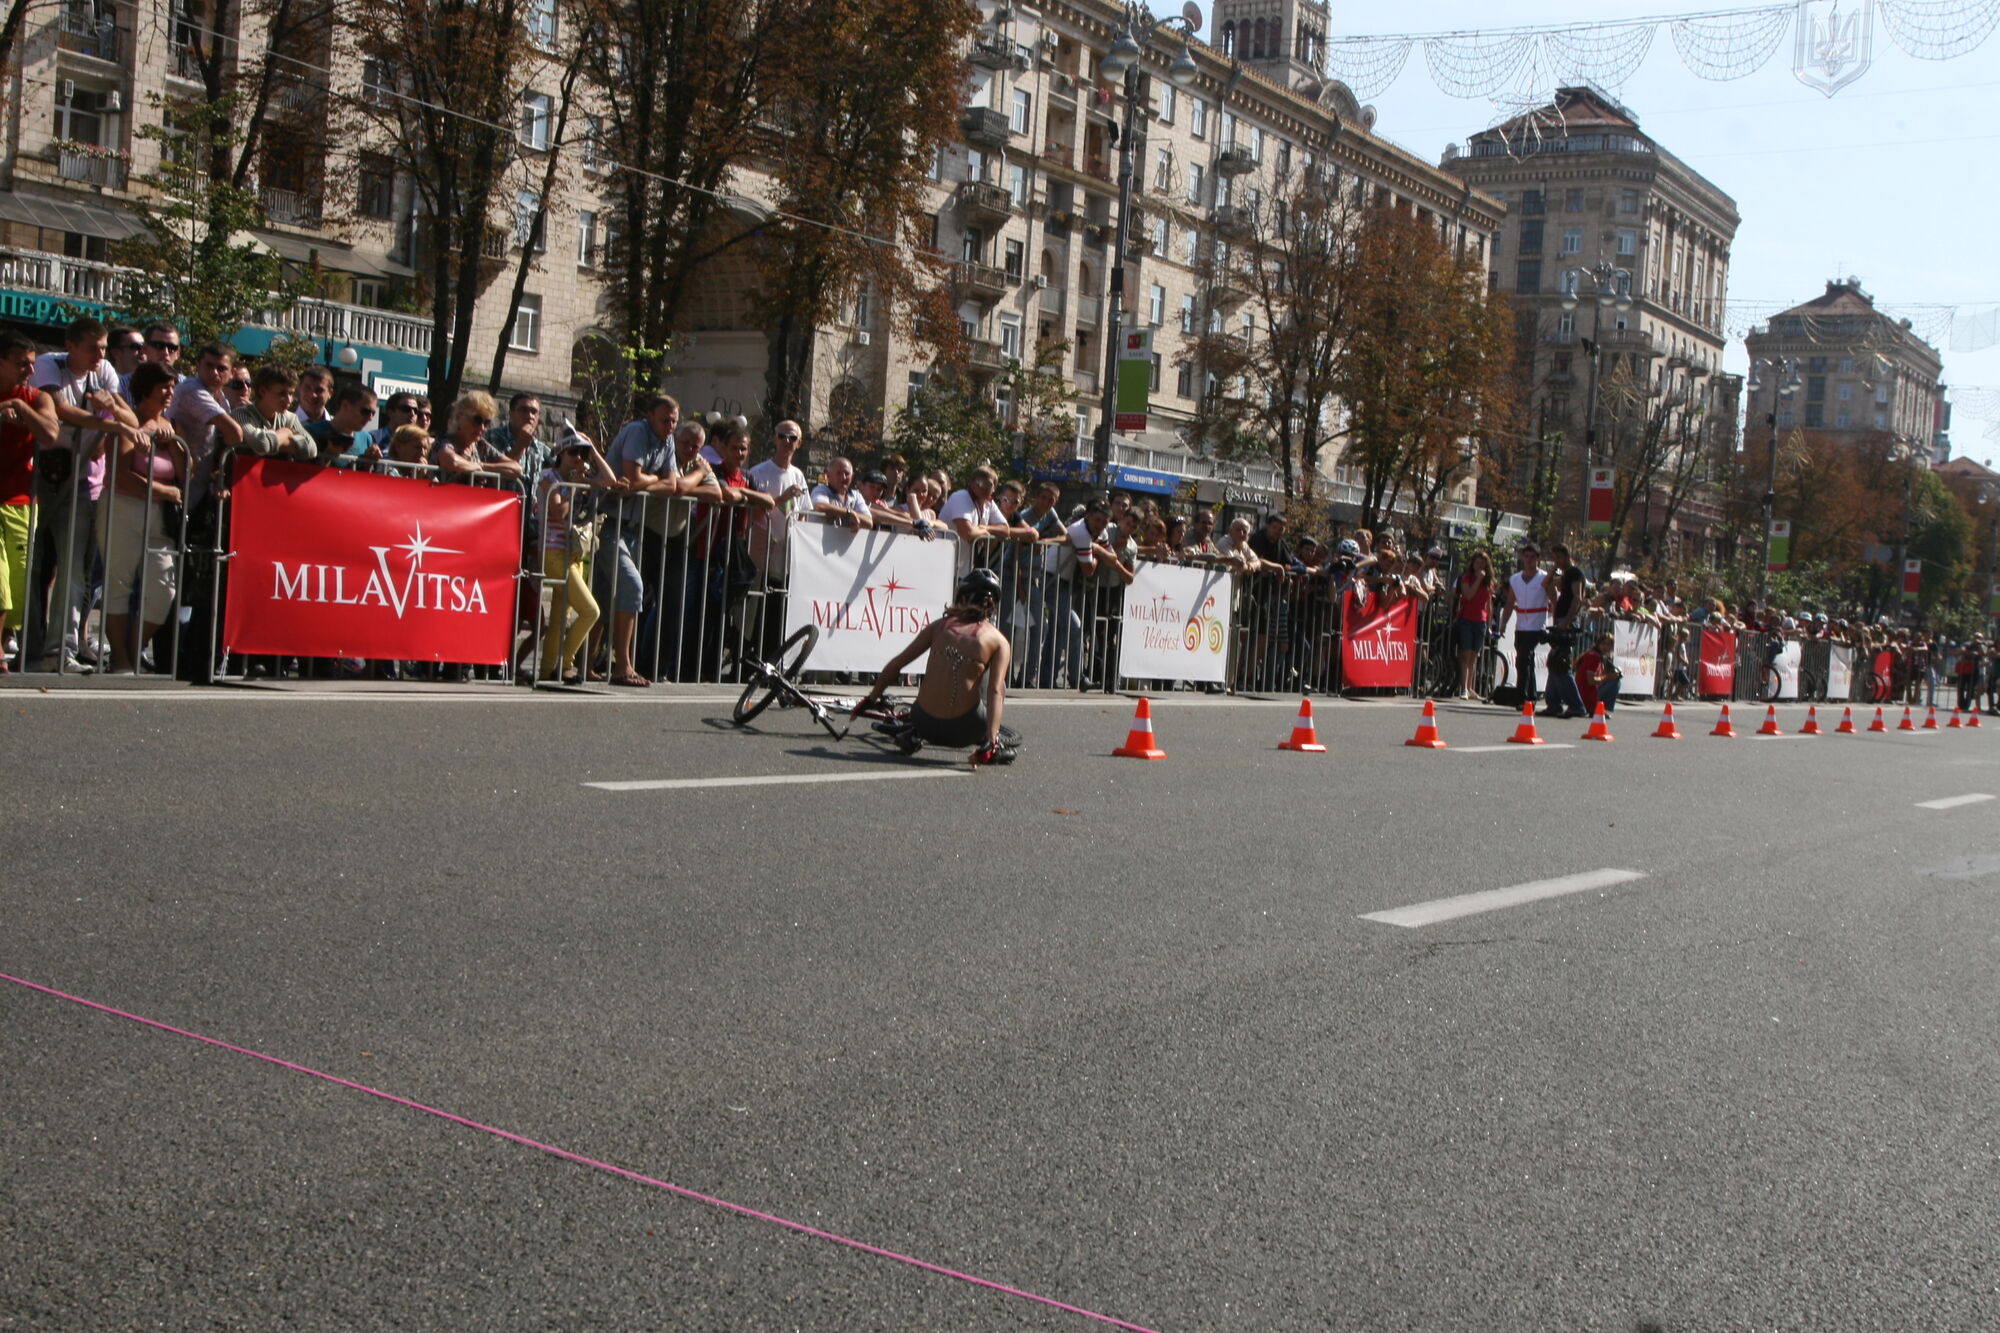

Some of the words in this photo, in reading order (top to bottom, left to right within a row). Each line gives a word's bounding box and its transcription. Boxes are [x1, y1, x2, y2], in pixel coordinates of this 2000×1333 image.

[270, 545, 488, 619] MILAVITSA
[811, 587, 932, 640] MILAVITSA
[1129, 597, 1181, 625] MILAVITSA
[1142, 626, 1180, 653] Velofest
[1352, 629, 1409, 667] MILAVITSA
